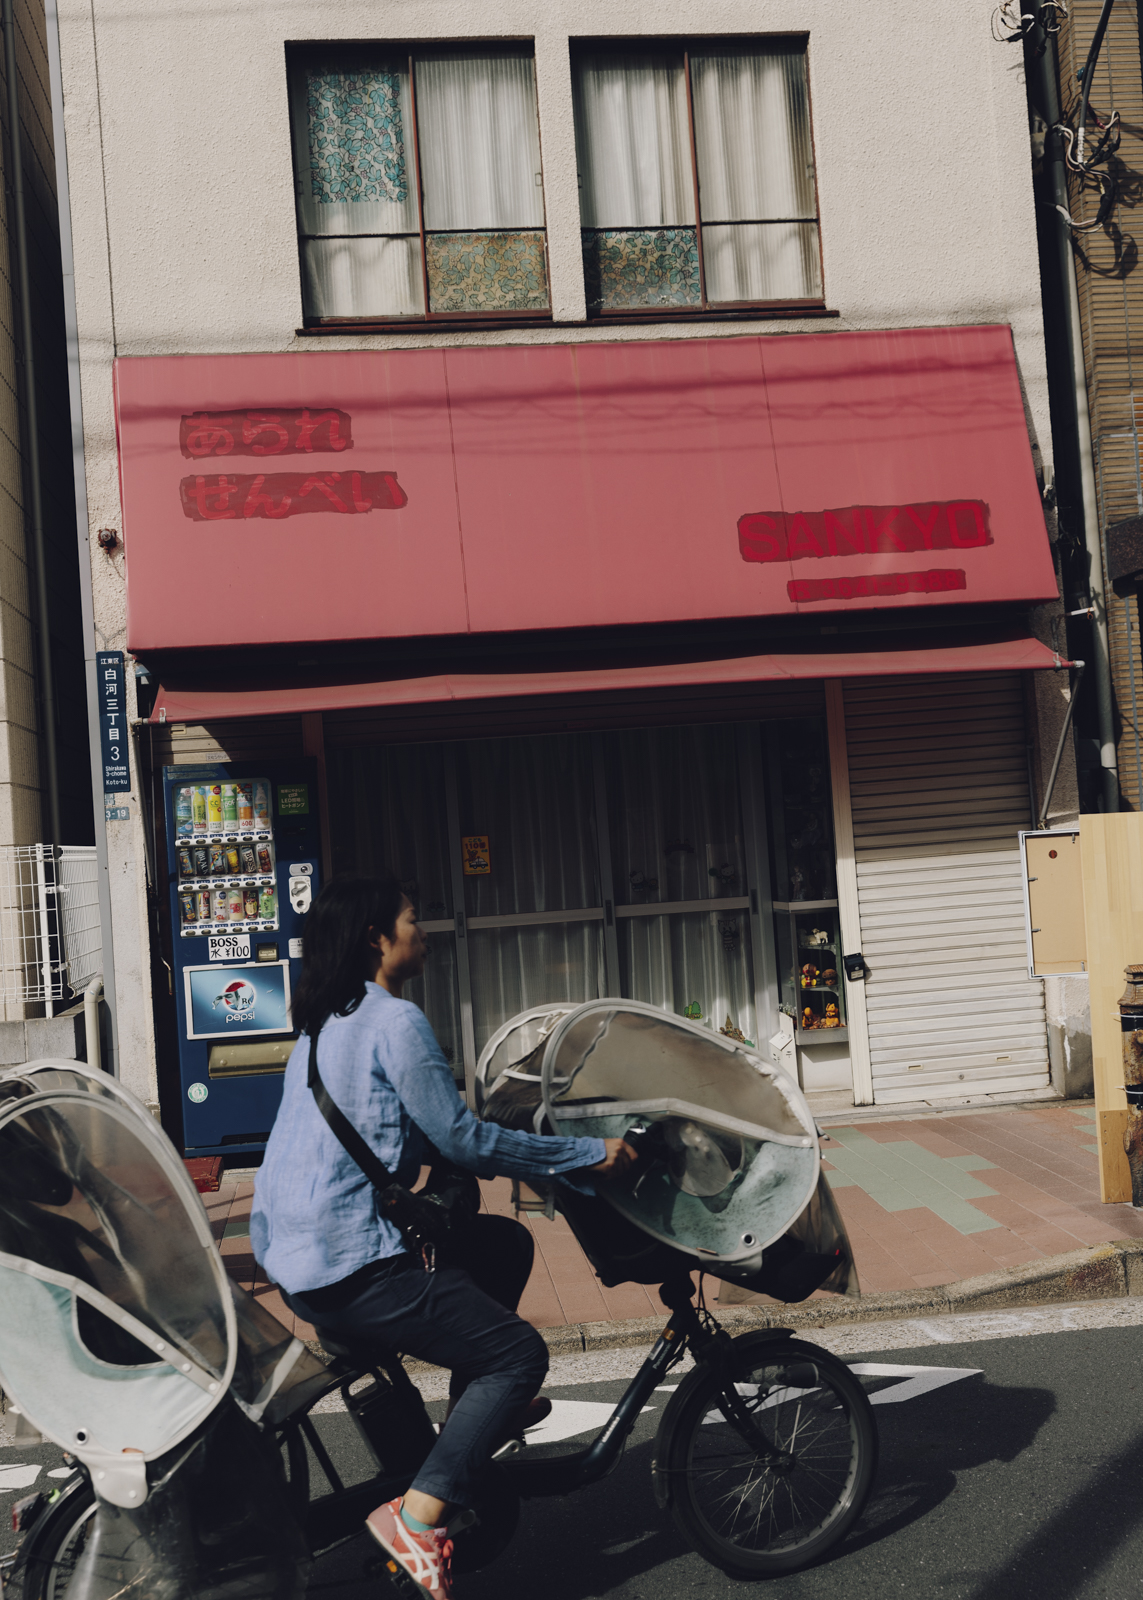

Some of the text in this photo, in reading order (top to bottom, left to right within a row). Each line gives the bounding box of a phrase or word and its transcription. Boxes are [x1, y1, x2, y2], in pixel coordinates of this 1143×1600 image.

[185, 410, 348, 456] あられ
[187, 471, 405, 520] せんべい
[738, 501, 987, 562] SANKYO
[822, 570, 959, 598] 3641-9388
[101, 657, 120, 665] 江東区
[104, 668, 120, 761] 白河三丁目 3
[105, 778, 128, 786] Koto-ku
[105, 809, 126, 819] 3-19
[210, 937, 238, 948] BOSS
[210, 945, 250, 959] 水 ¥100
[225, 1010, 256, 1024] pepsi
